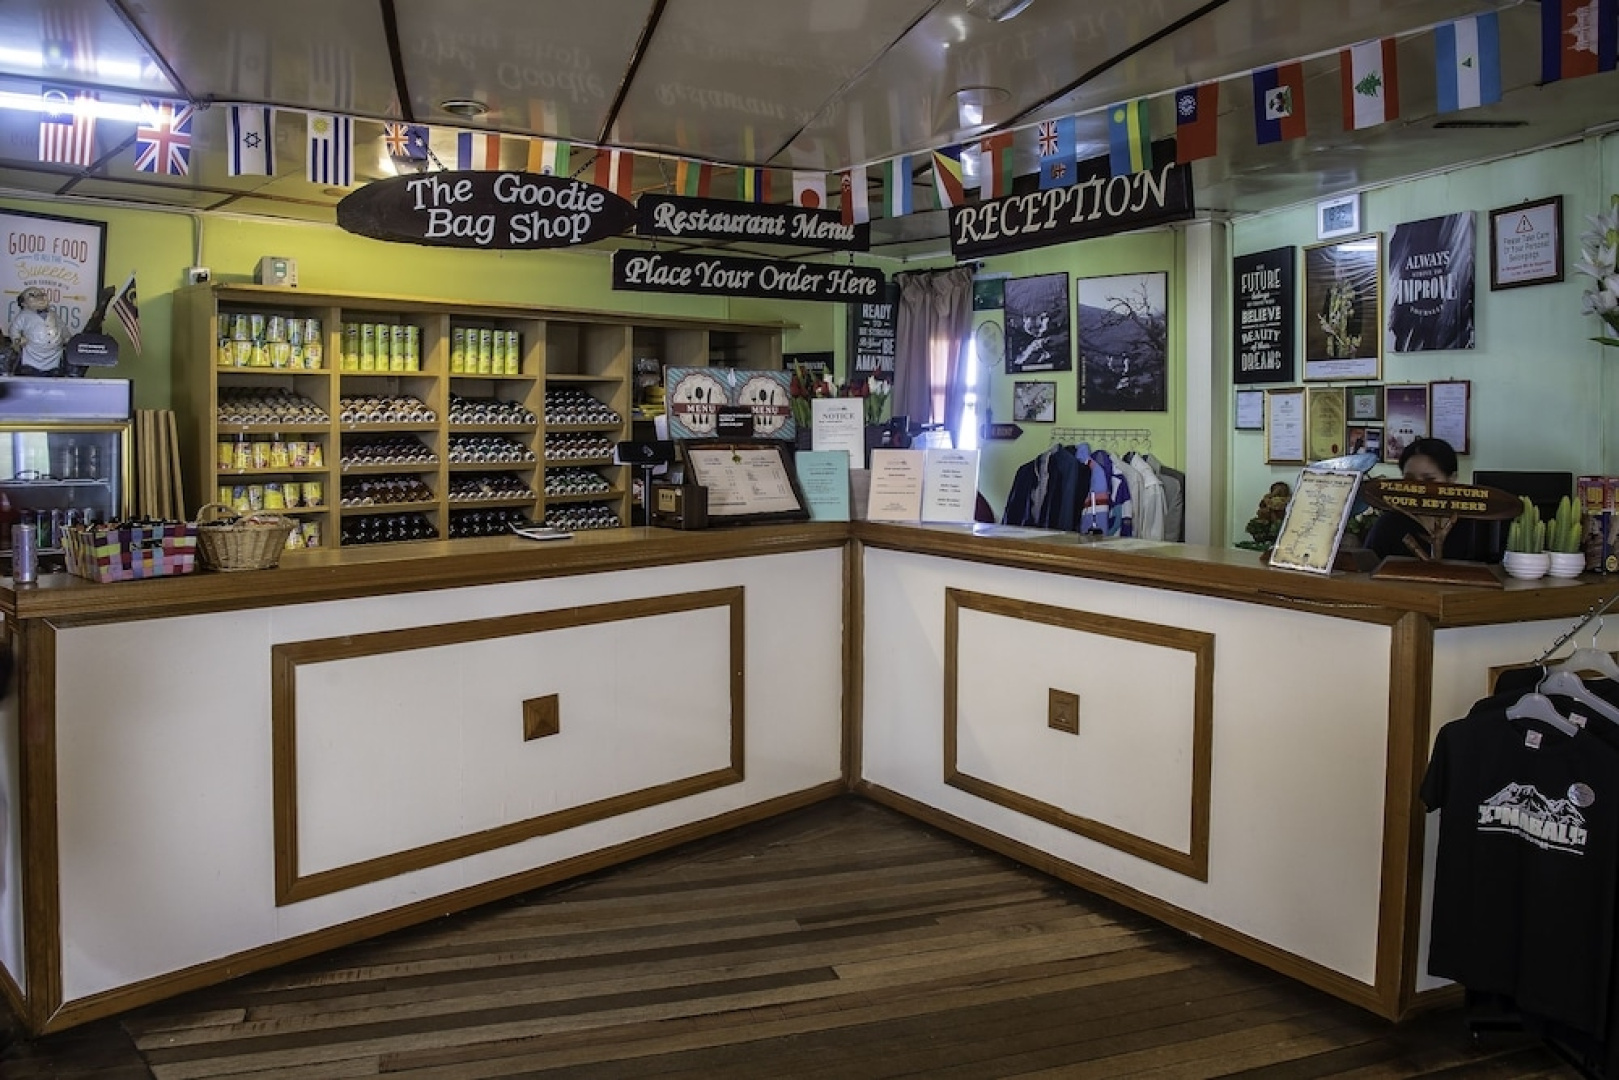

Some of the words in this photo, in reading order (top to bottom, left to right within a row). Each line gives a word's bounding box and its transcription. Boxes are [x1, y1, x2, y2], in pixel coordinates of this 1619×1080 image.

[406, 176, 473, 210] The
[494, 174, 605, 213] Goodie
[954, 162, 1176, 245] RECEPTION
[424, 209, 496, 244] Bag
[510, 211, 591, 243] Shop
[653, 202, 786, 235] Restaurant
[791, 213, 855, 240] Menu
[8, 232, 46, 255] GOOD
[53, 237, 88, 263] FOOD
[1405, 250, 1450, 270] ALWAYS
[625, 256, 691, 286] Place
[696, 261, 754, 289] Your
[759, 264, 823, 292] Order
[826, 270, 877, 296] Here
[1241, 268, 1281, 293] FUTURE
[1397, 272, 1458, 305] IMPROVE
[862, 304, 892, 319] READY
[1241, 306, 1281, 324] BELIEVE
[1241, 328, 1281, 345] BEAUTY
[1241, 351, 1281, 371] DREAMS
[687, 404, 716, 413] MENU
[751, 406, 779, 415] MENU
[822, 412, 856, 420] NOTICE
[1380, 482, 1426, 495] PLEASE
[1438, 486, 1489, 499] RETURN
[1382, 495, 1418, 508] YOUR
[1422, 498, 1448, 510] KEY
[1450, 499, 1487, 511] HERE
